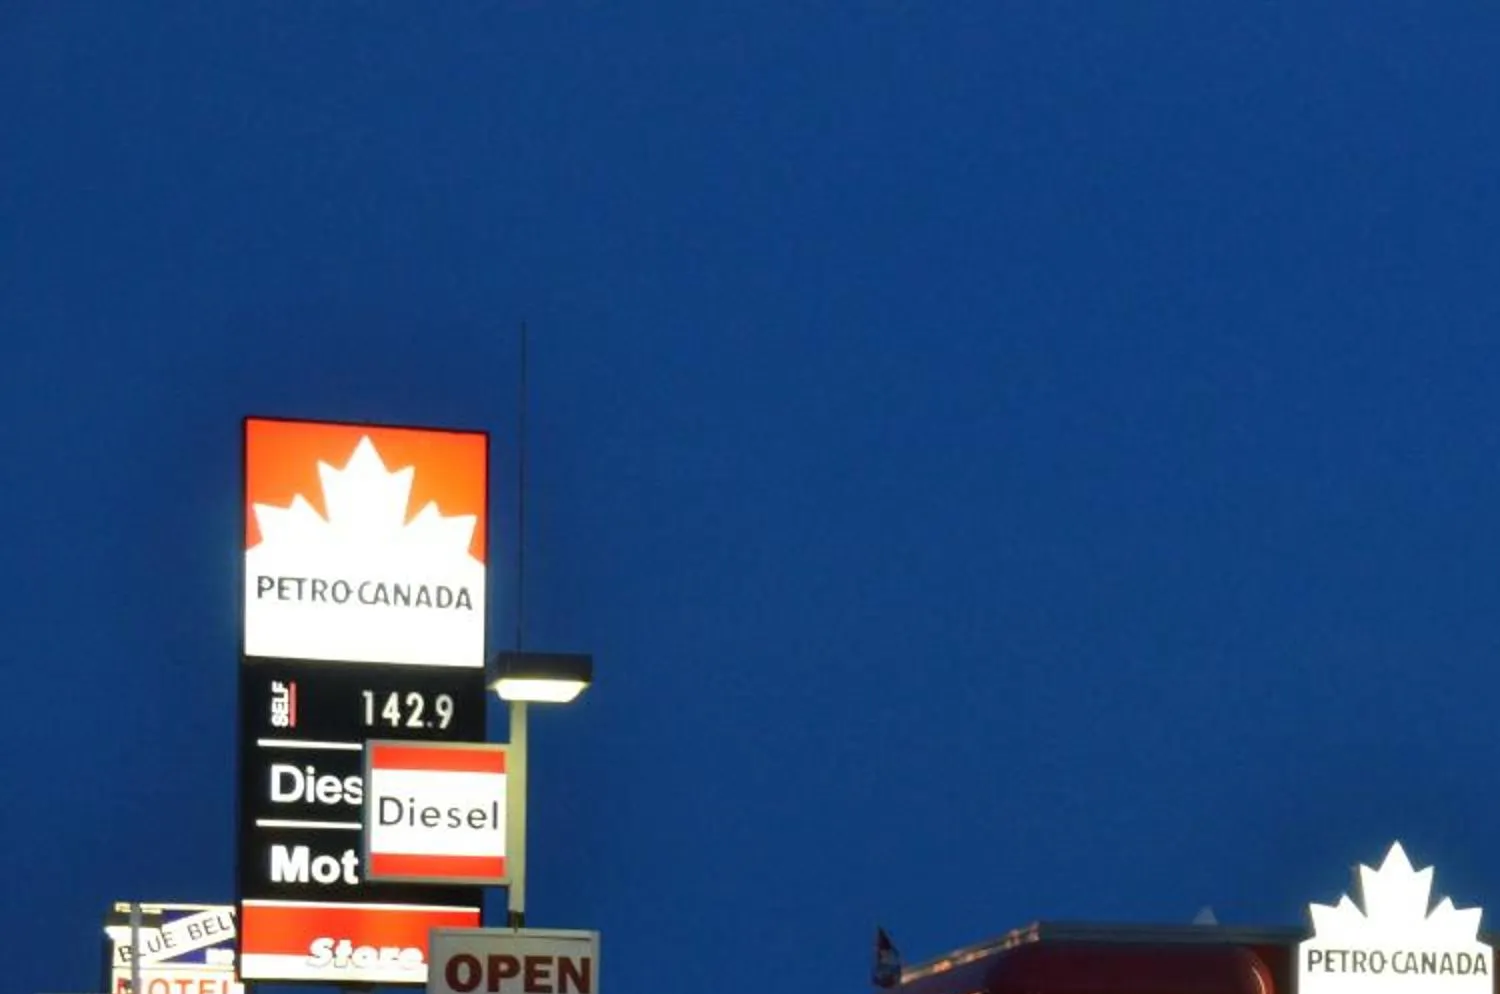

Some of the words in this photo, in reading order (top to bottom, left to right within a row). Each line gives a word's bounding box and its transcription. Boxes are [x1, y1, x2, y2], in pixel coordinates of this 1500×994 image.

[271, 681, 288, 727] SELF
[363, 690, 454, 729] 142.9
[270, 764, 363, 804] Dies
[379, 796, 498, 830] Diesel
[271, 845, 359, 885] Mot
[118, 931, 177, 963] BUE
[306, 937, 425, 969] Store
[445, 953, 591, 994] OPEN
